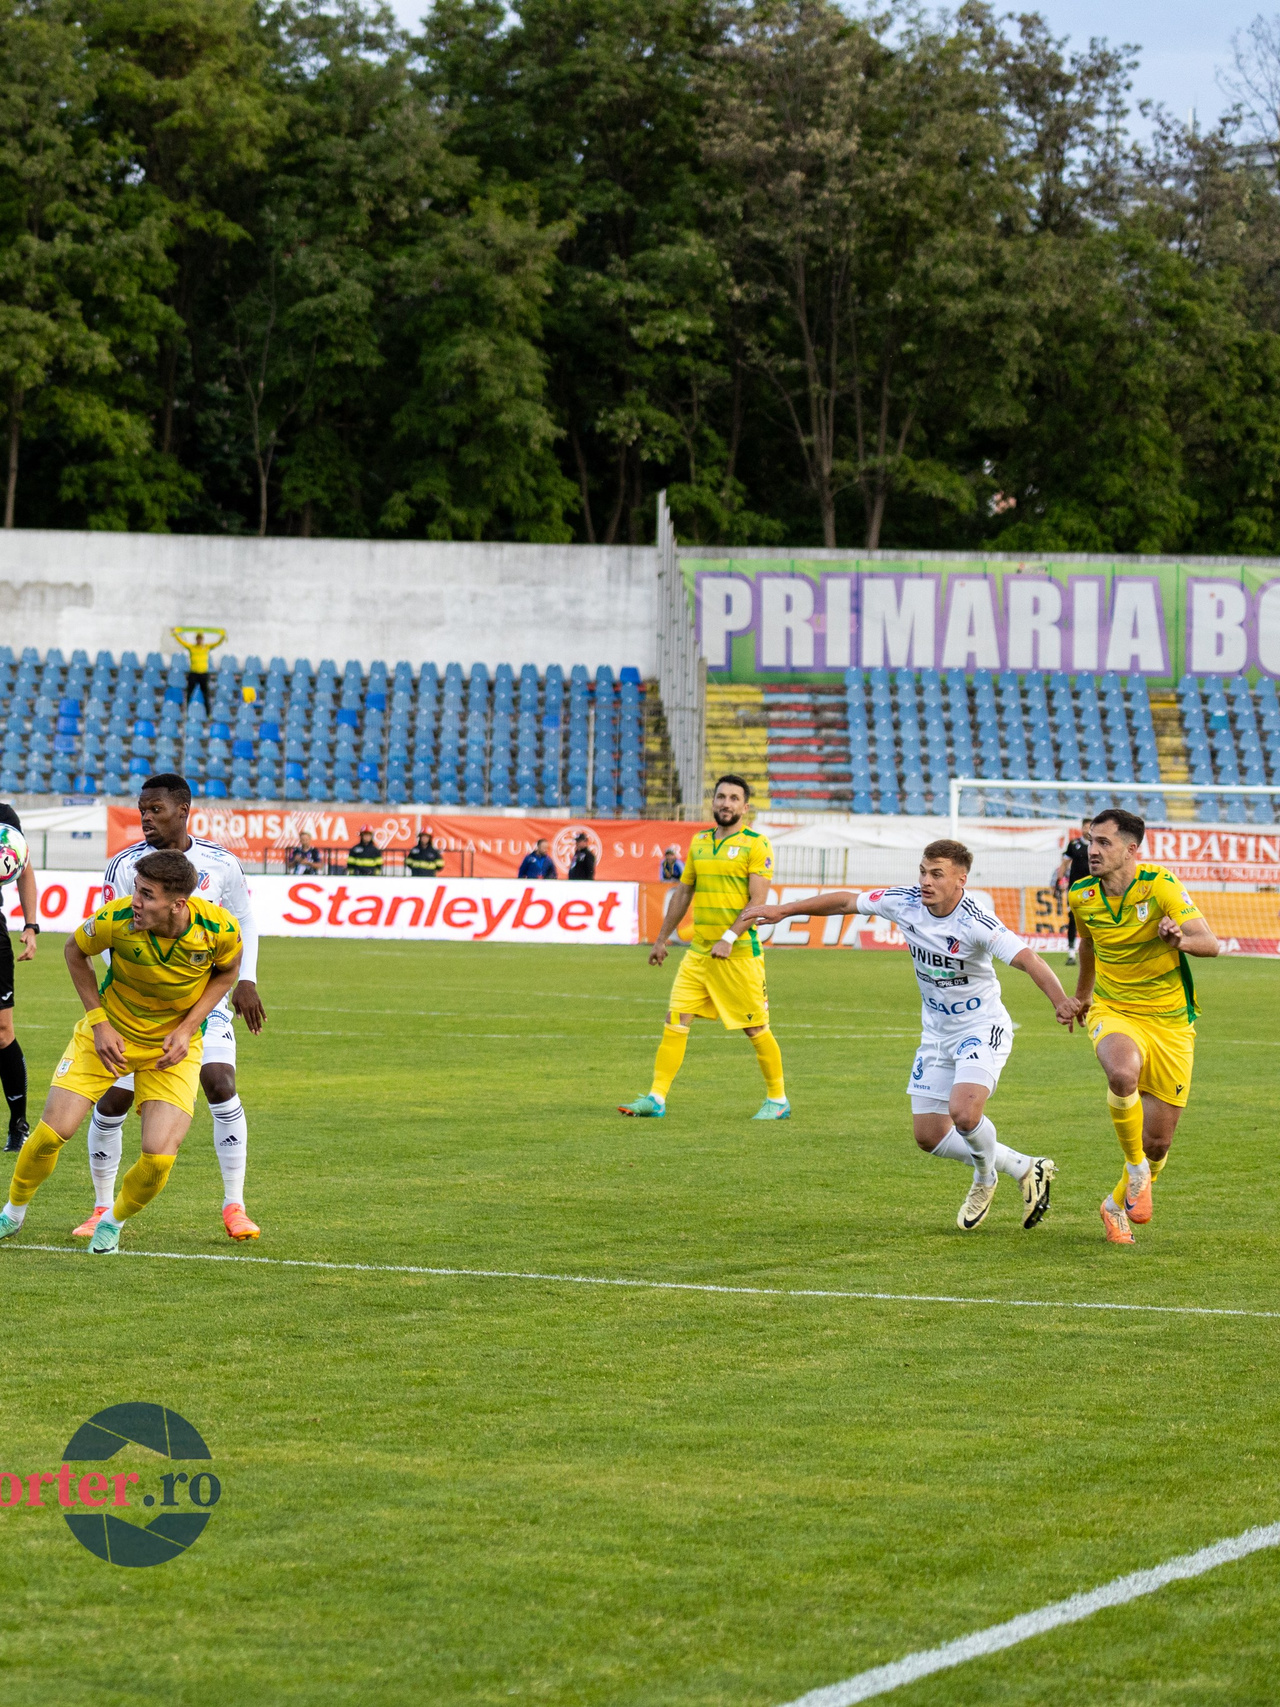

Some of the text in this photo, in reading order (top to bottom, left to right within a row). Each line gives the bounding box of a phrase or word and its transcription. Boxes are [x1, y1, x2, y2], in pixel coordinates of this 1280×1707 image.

[699, 576, 1167, 673] PRIMARIA
[187, 812, 350, 842] ORONSKAYA
[283, 881, 620, 941] Stanleybet
[908, 943, 966, 971] UNIBET
[921, 992, 981, 1016] LSACO
[912, 1055, 924, 1081] 3
[913, 1082, 931, 1091] Vestra
